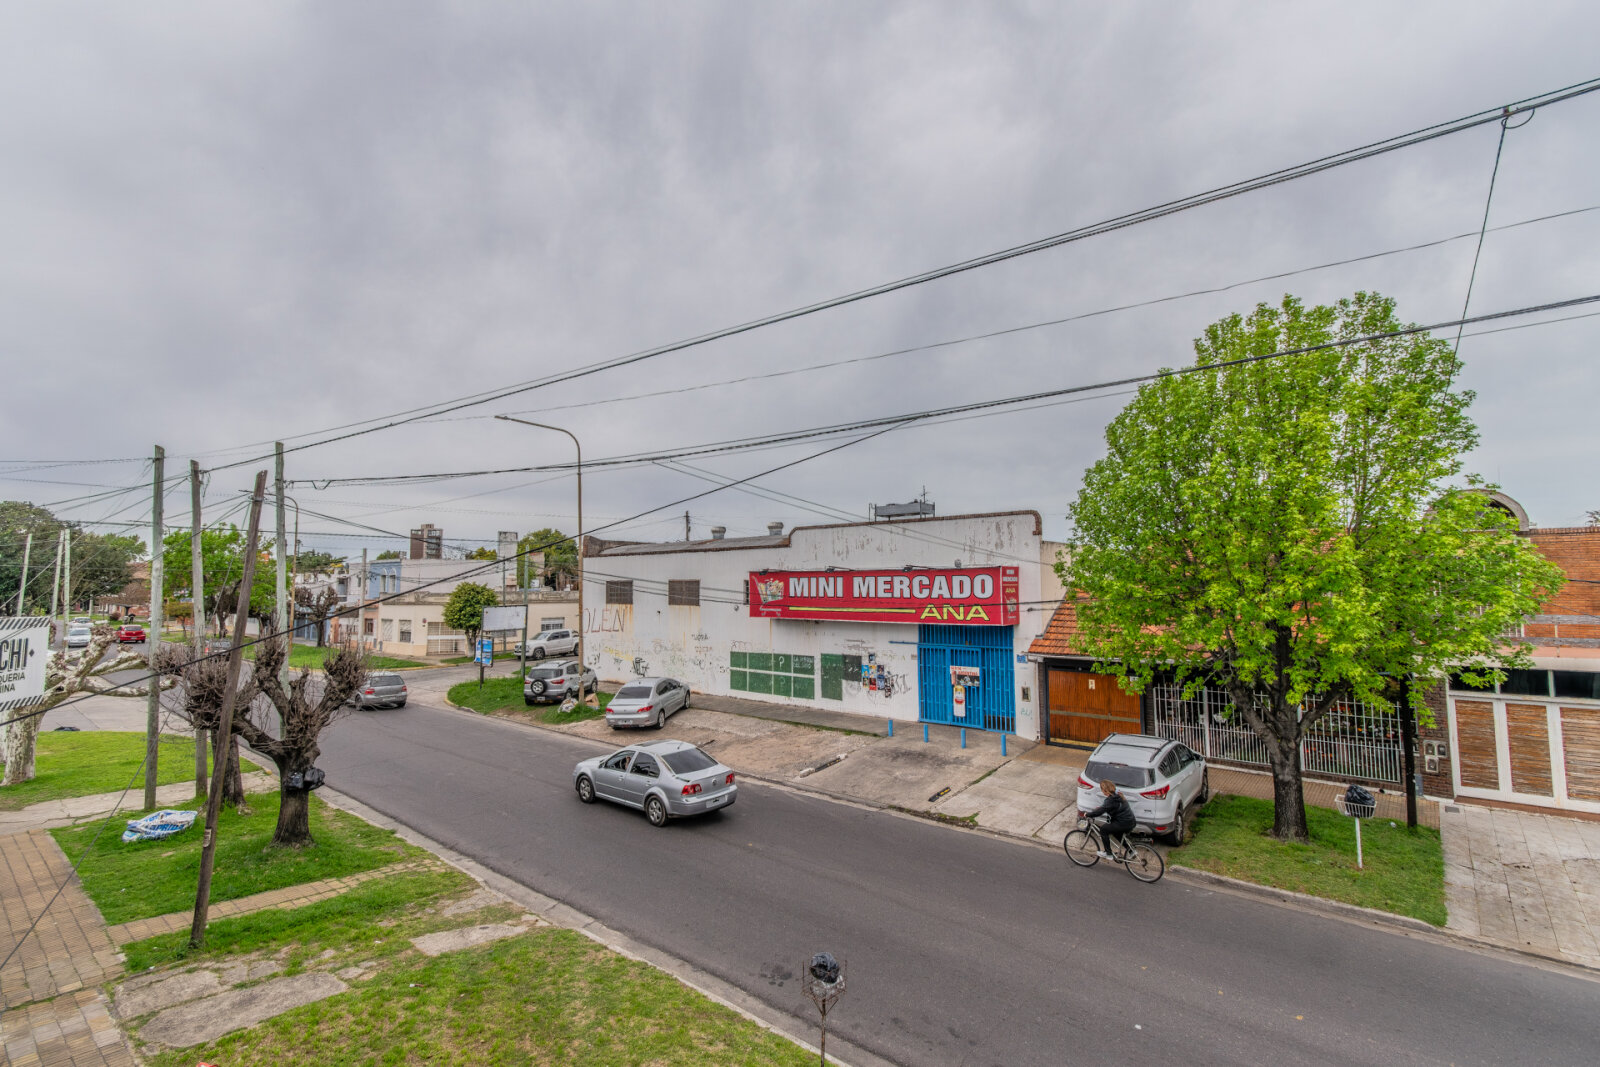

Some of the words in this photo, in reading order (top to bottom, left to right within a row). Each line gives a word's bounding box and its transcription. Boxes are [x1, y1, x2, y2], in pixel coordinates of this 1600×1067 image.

[789, 576, 844, 598] MINI
[853, 574, 994, 599] MERCADO
[920, 604, 990, 621] ANA
